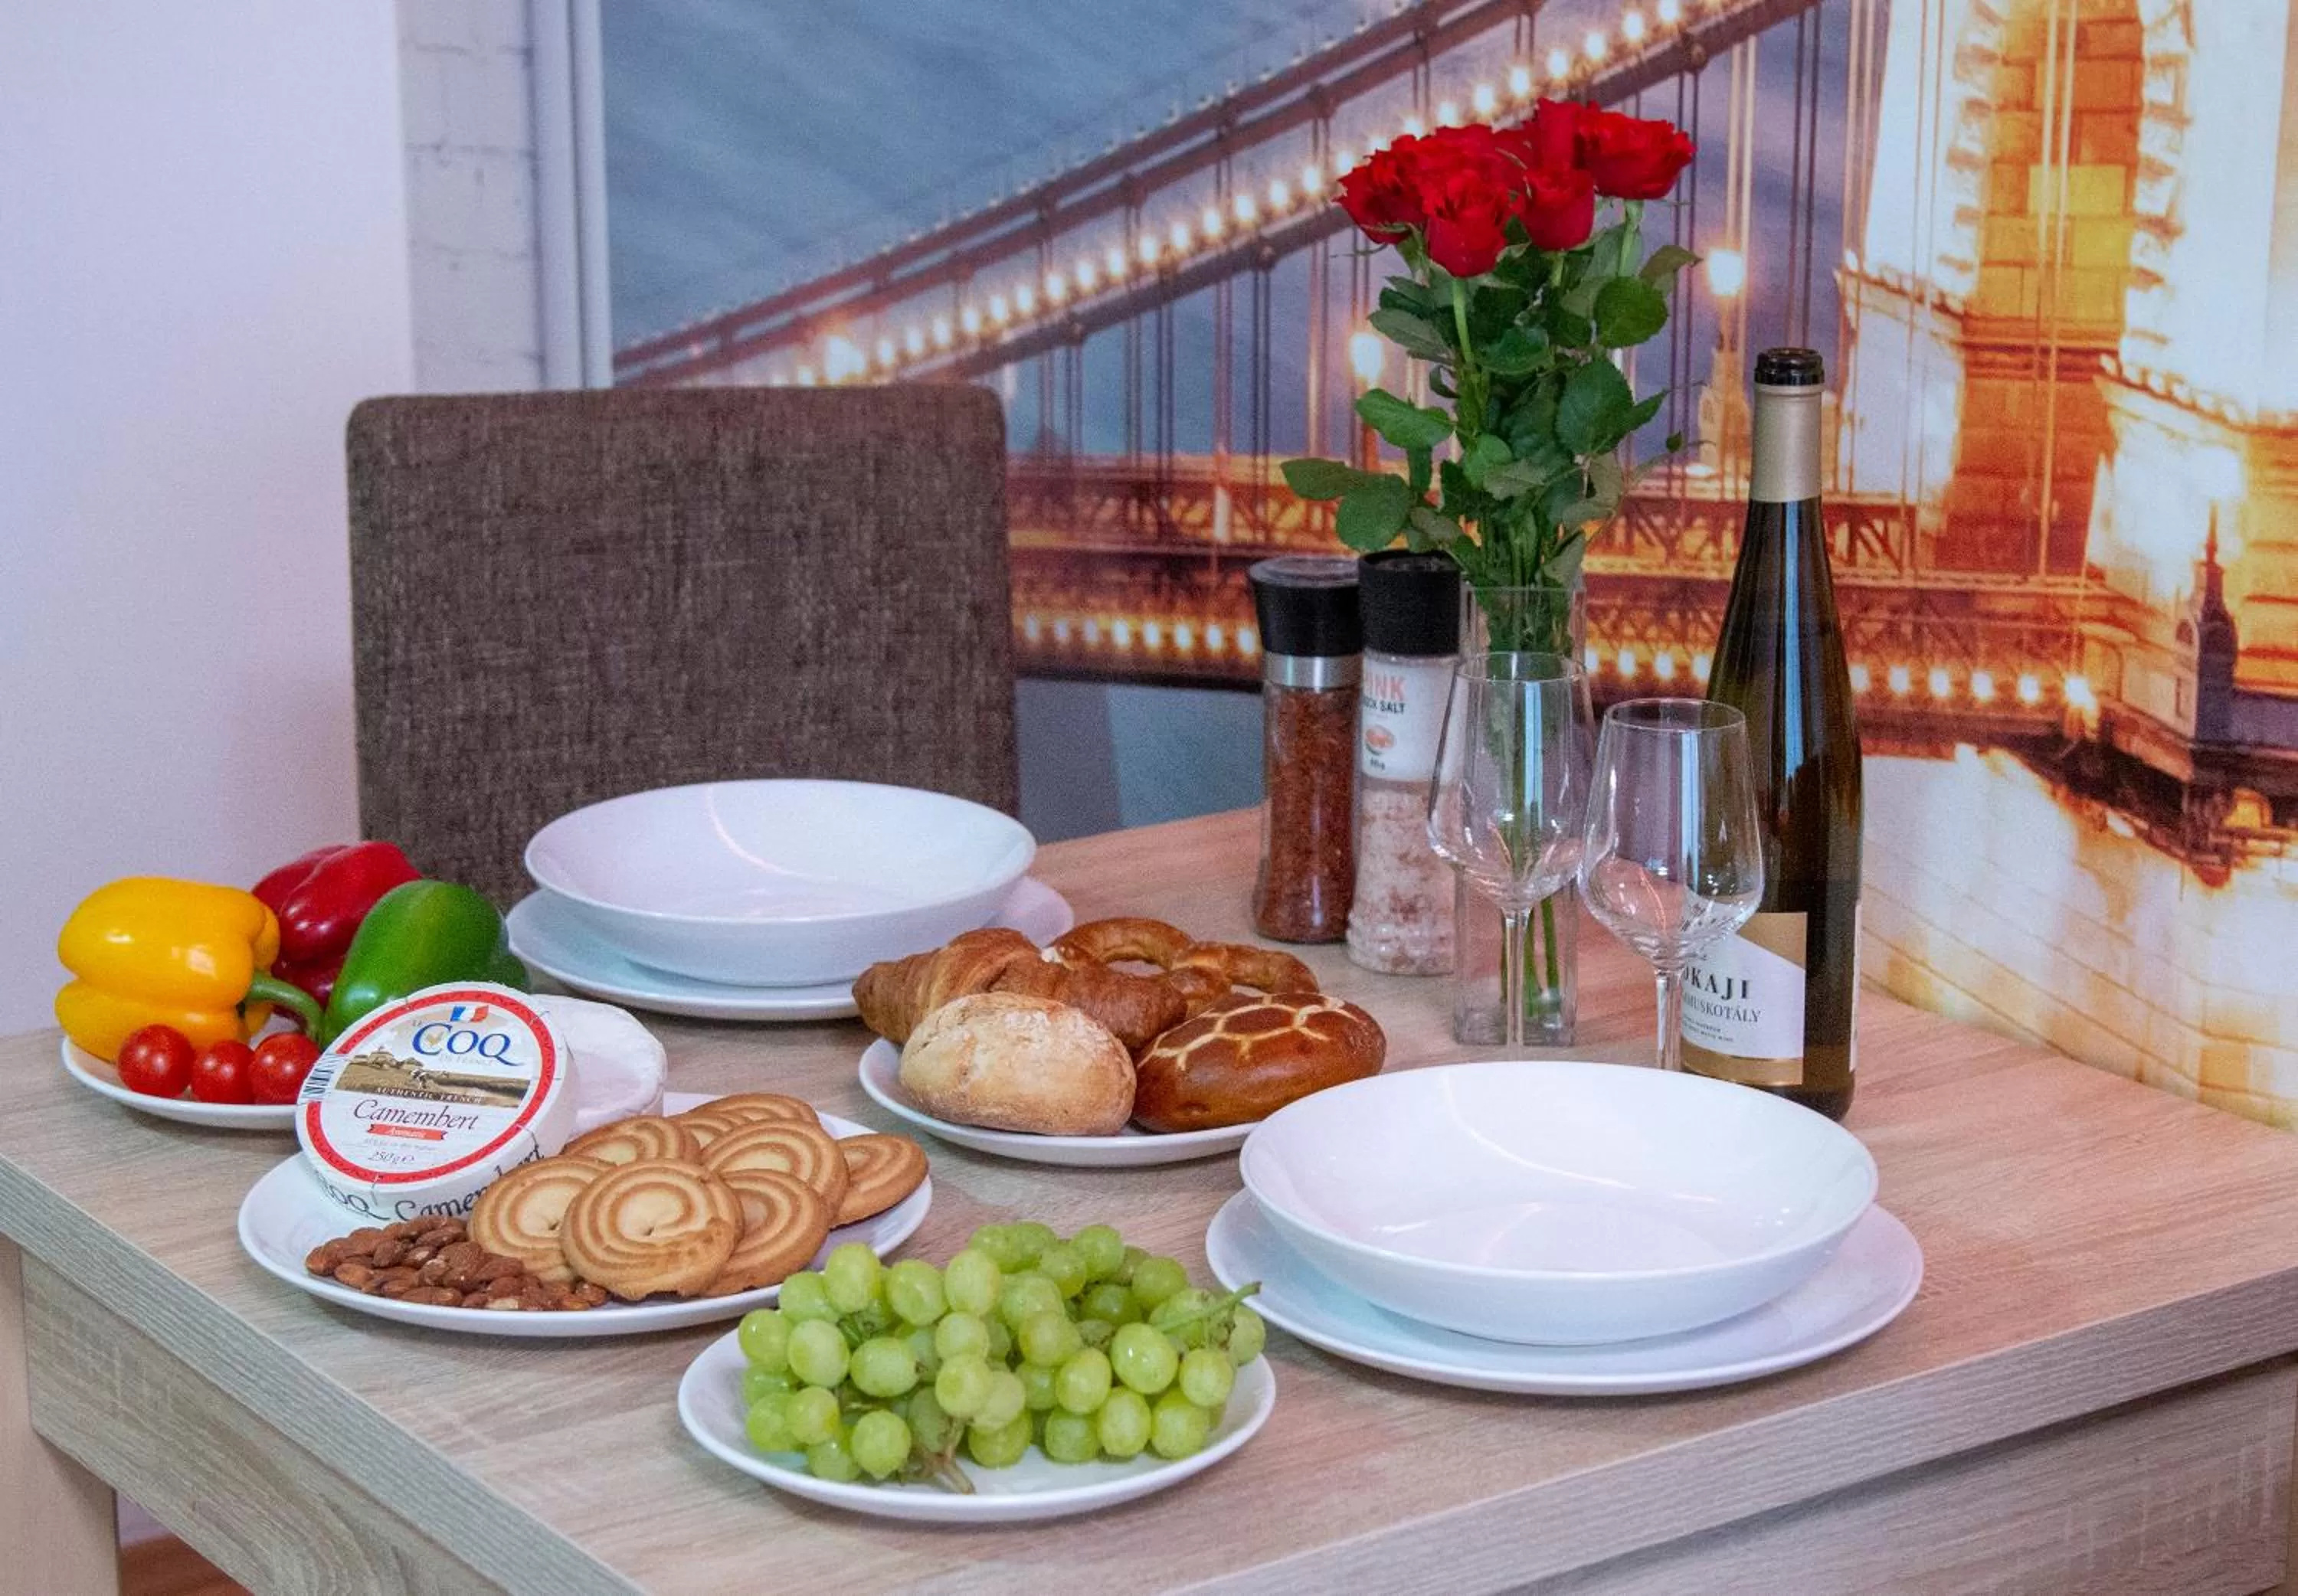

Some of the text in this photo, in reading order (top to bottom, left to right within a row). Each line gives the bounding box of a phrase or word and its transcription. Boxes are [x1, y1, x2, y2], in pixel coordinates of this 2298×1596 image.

[1366, 671, 1406, 702] INK
[1380, 699, 1405, 715] SALT
[1683, 965, 1753, 1001] OKAJI
[412, 1022, 525, 1067] COQ
[375, 1086, 482, 1104] AUTHENTIC FRENCH
[353, 1099, 479, 1130] Camembert
